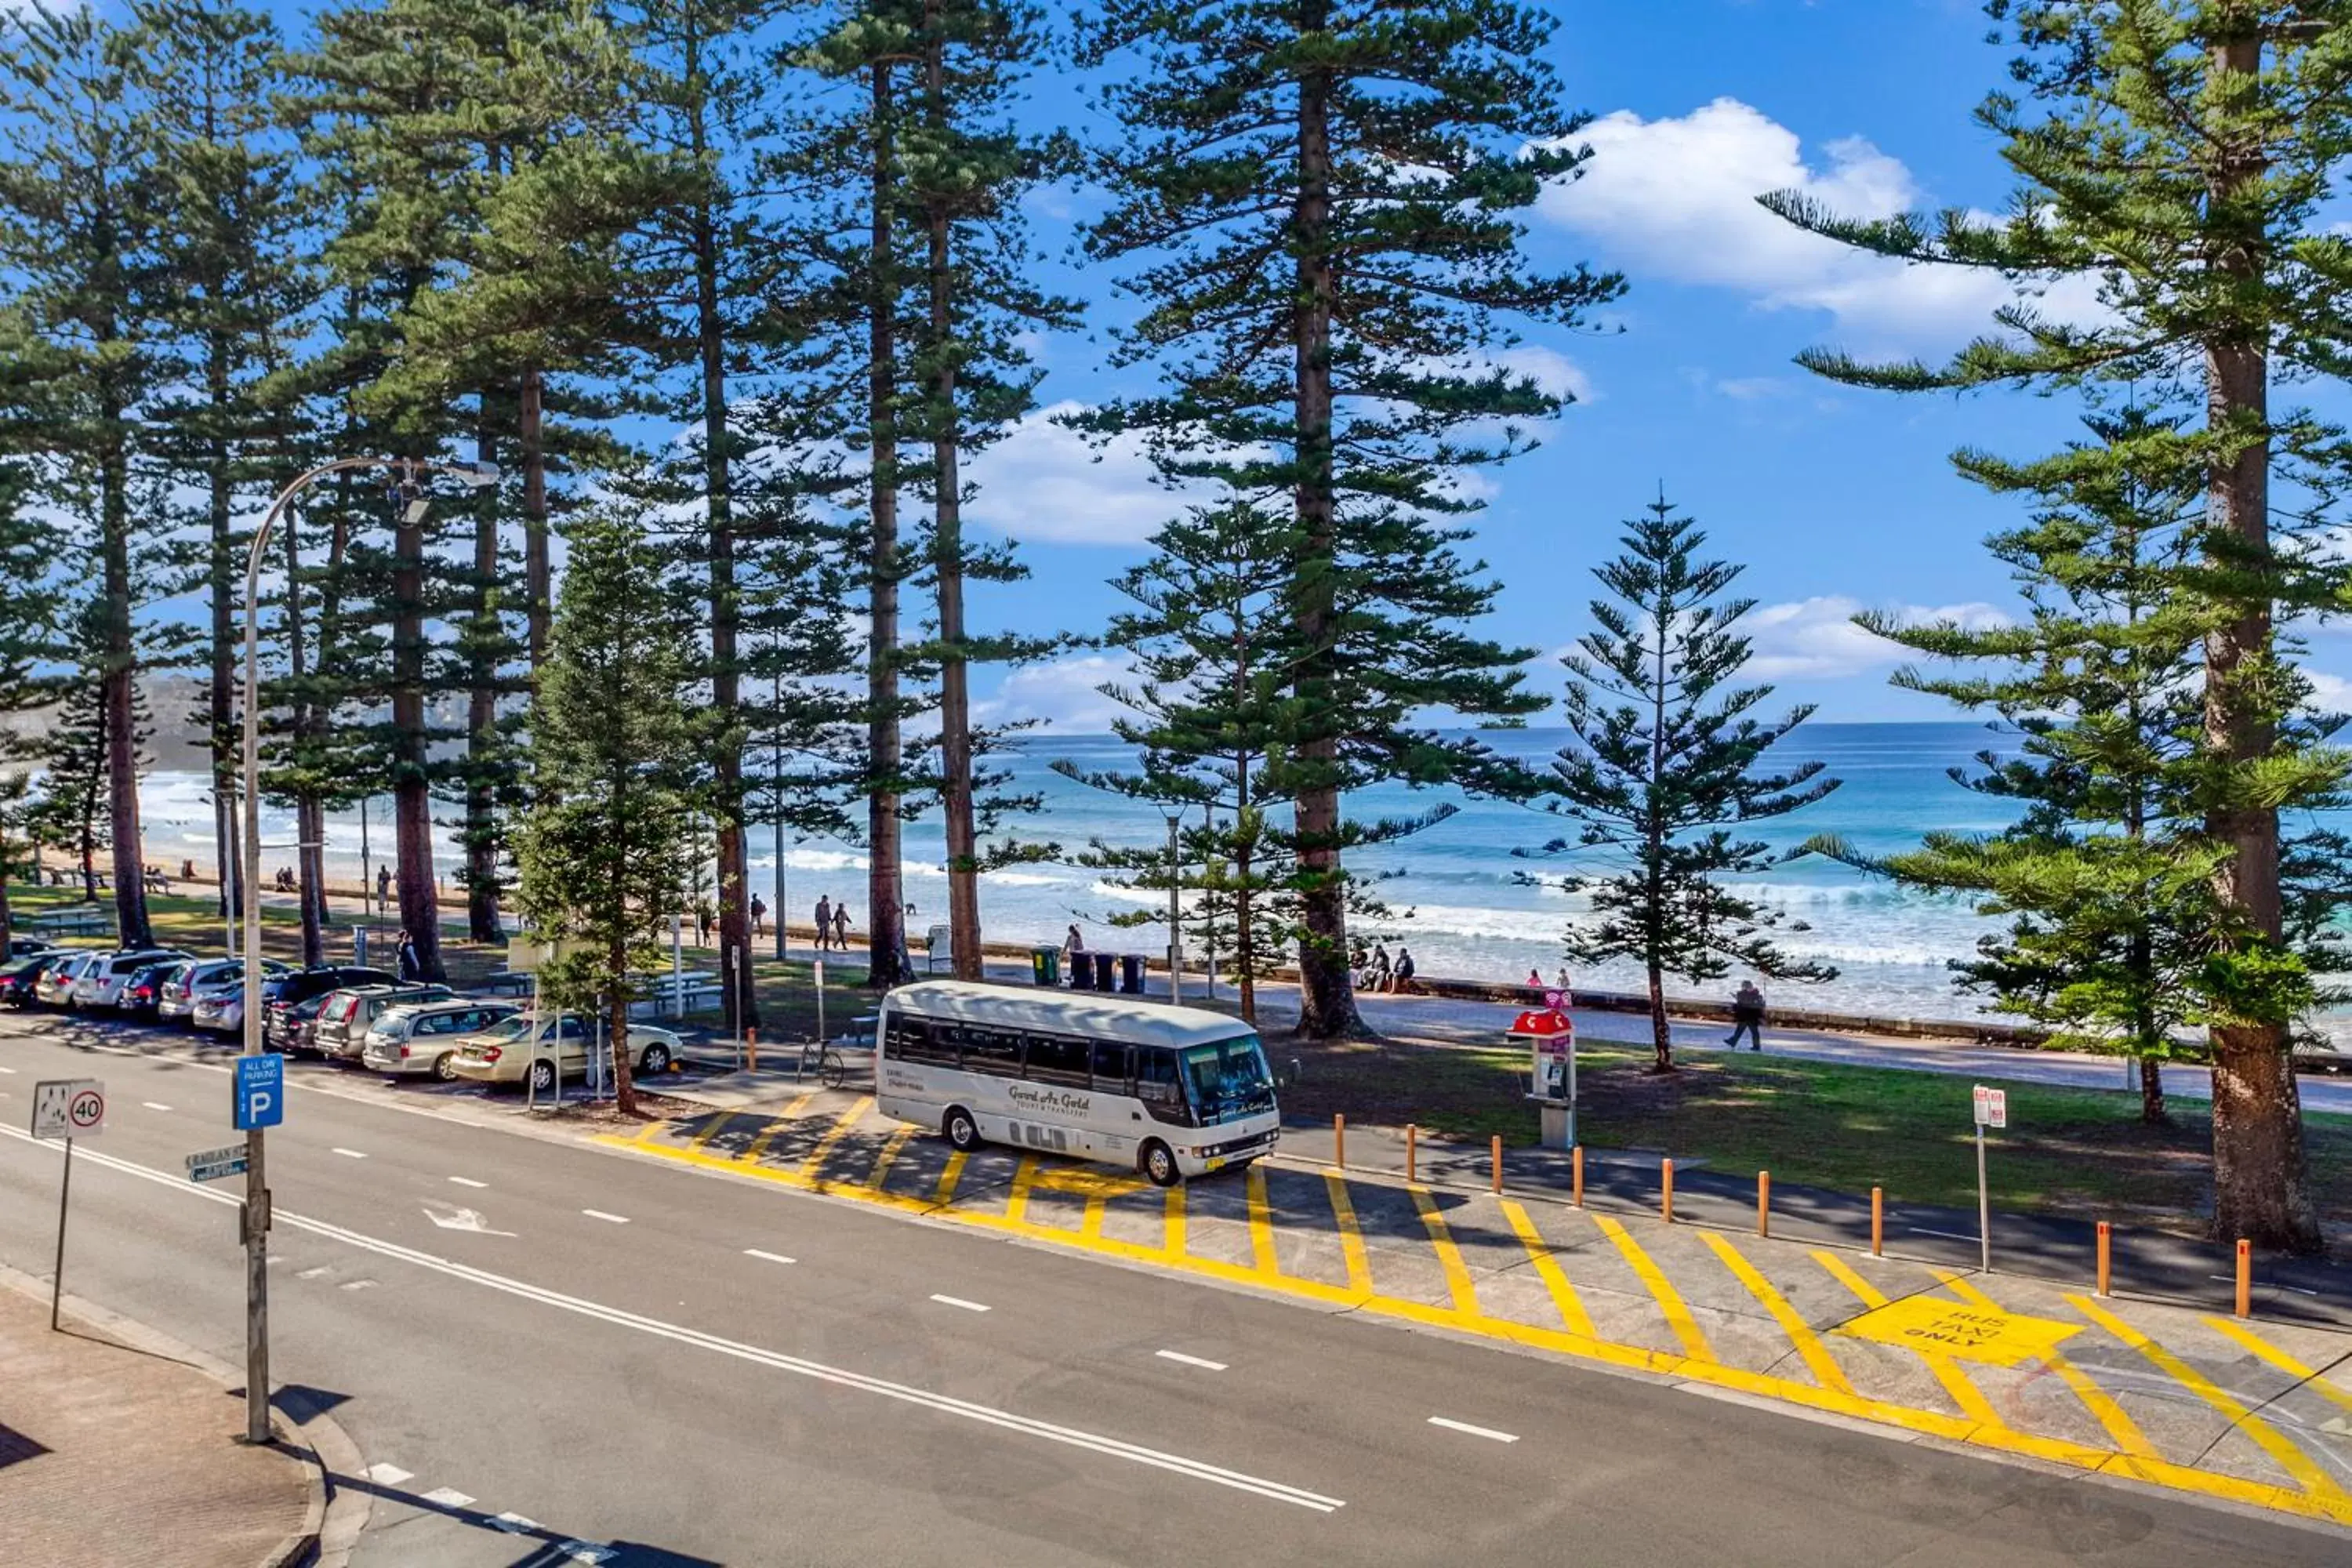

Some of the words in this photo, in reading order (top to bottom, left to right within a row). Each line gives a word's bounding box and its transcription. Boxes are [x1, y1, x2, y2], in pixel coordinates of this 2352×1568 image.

[245, 1061, 260, 1070] ALL
[1009, 1085, 1038, 1102] Good
[1061, 1094, 1089, 1109] Gold
[75, 1100, 100, 1117] 40
[251, 1092, 271, 1123] P
[1947, 1312, 2008, 1327] BUS
[1904, 1329, 1986, 1346] ONLY
[1930, 1320, 2002, 1338] TAXI
